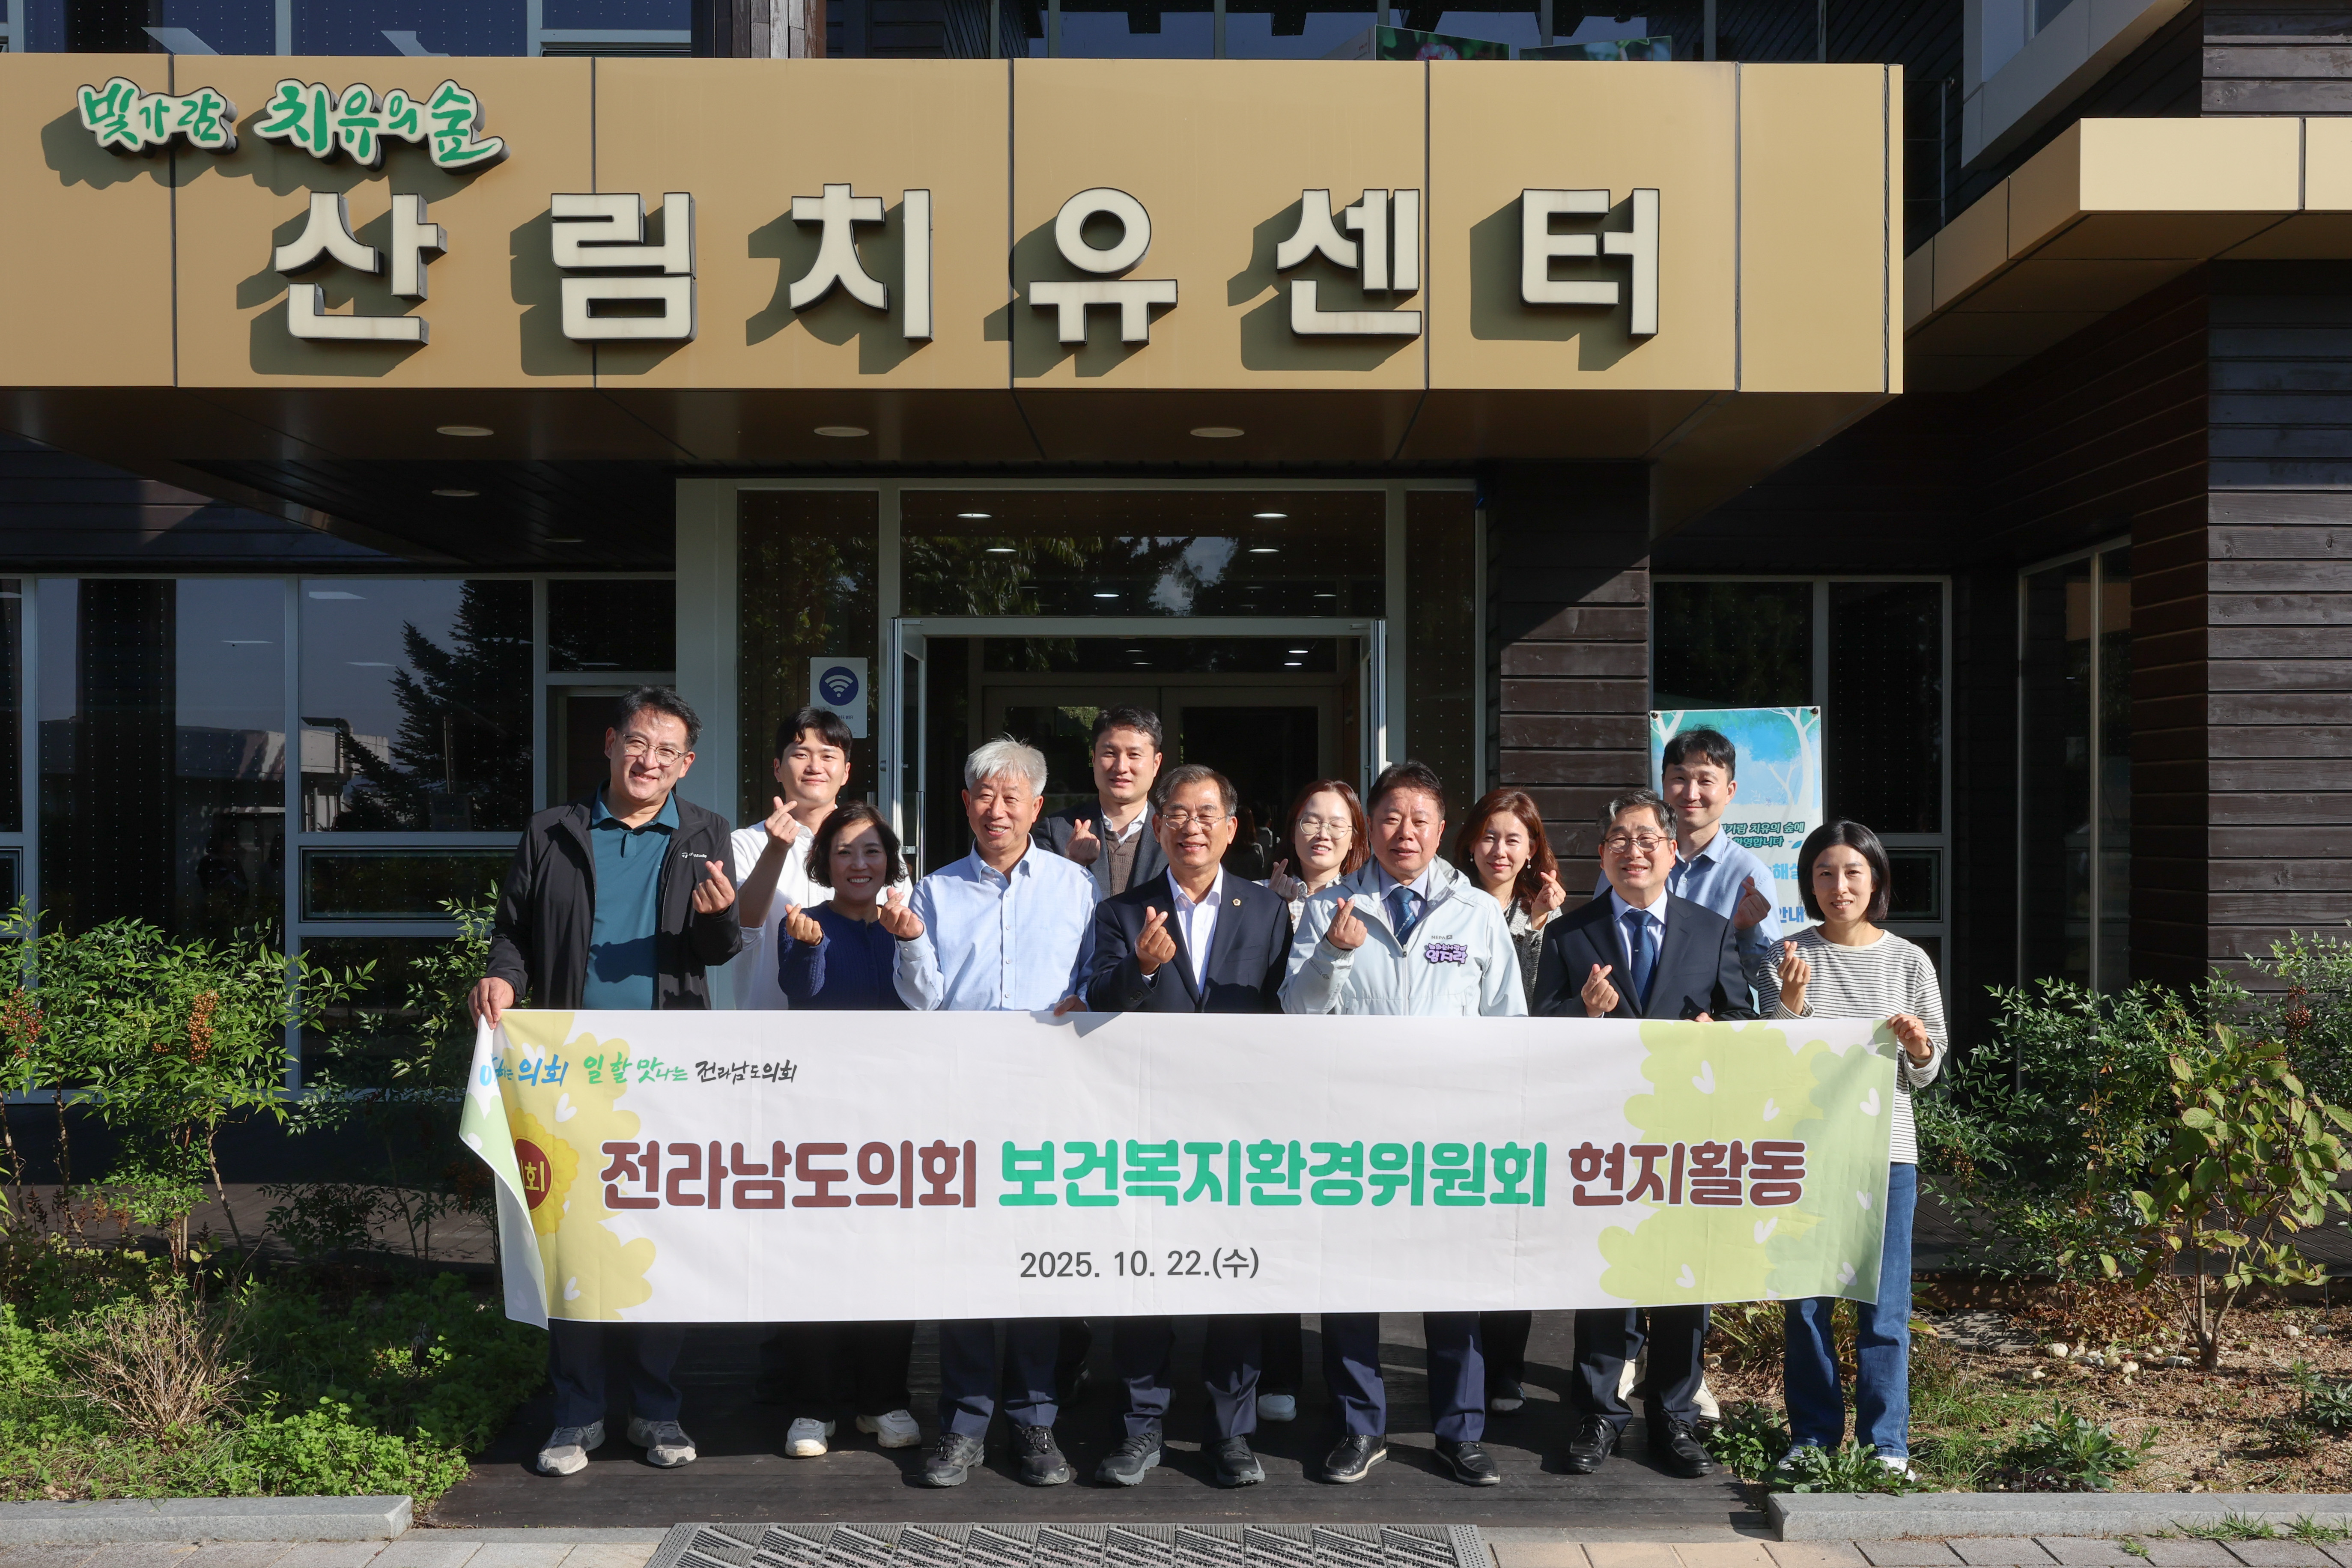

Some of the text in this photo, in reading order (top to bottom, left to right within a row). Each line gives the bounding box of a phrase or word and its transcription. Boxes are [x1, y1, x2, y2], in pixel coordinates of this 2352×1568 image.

[85, 83, 221, 146] 빛가람
[274, 183, 1660, 343] 산림치유센터
[1750, 822, 1781, 835] 치유의
[1783, 821, 1805, 833] 숲에
[518, 1054, 569, 1087] 의회
[695, 1059, 798, 1085] 전라남도의회
[601, 1139, 1805, 1210] 전라남도의회 보건복지환경위원회 현지활동
[1020, 1252, 1100, 1278] 2025.
[1115, 1250, 1155, 1277] 10.
